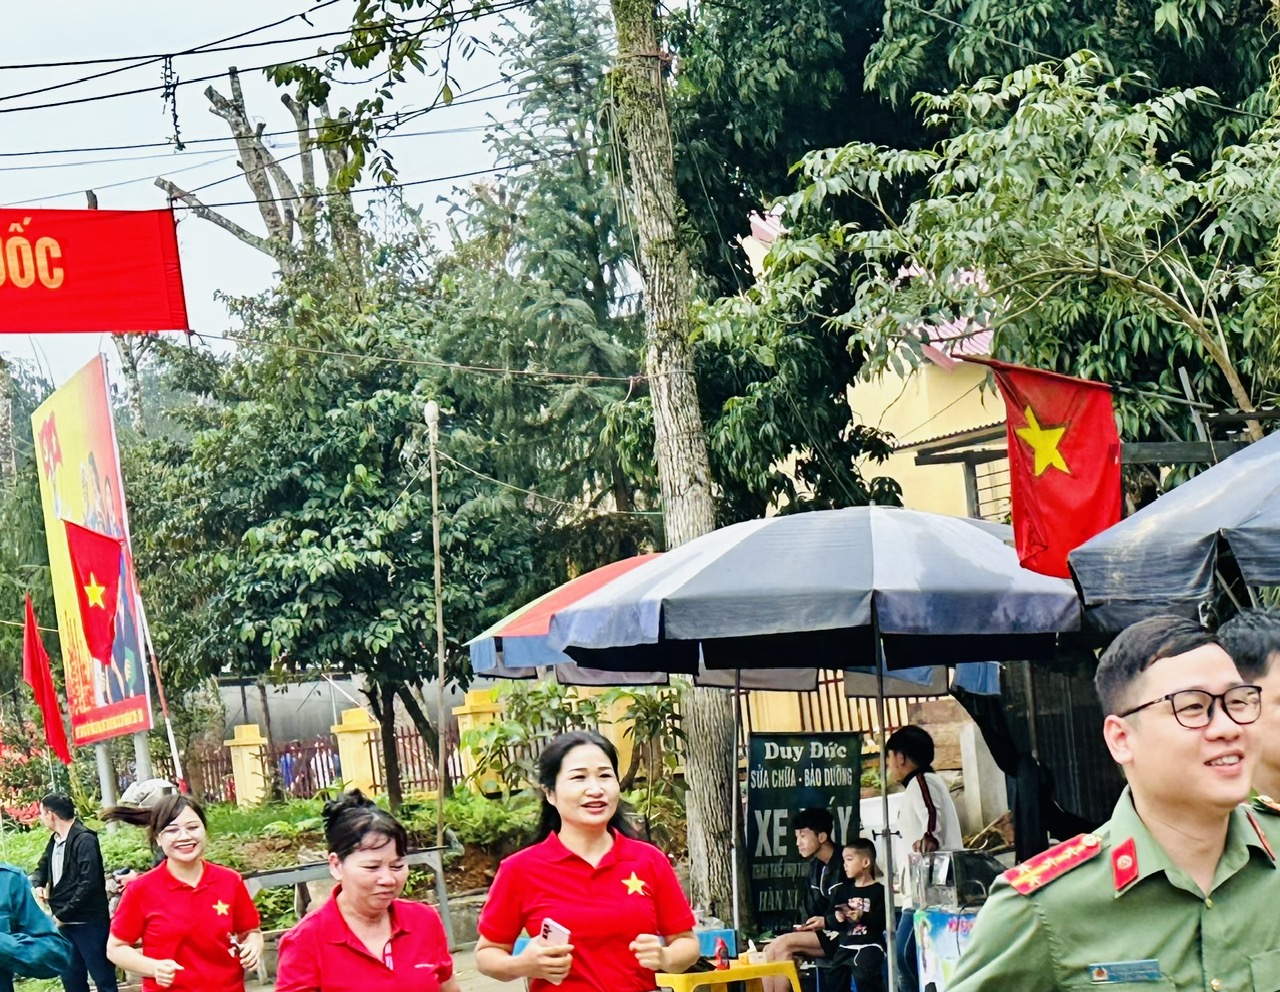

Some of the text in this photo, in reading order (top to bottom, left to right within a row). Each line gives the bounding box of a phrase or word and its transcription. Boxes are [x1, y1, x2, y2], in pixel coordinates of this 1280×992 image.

[0, 216, 65, 289] ỐC
[764, 741, 847, 762] Duy Đức
[750, 762, 852, 789] SỬA CHỮA BẢO DƯỠNG
[754, 808, 788, 857] XE
